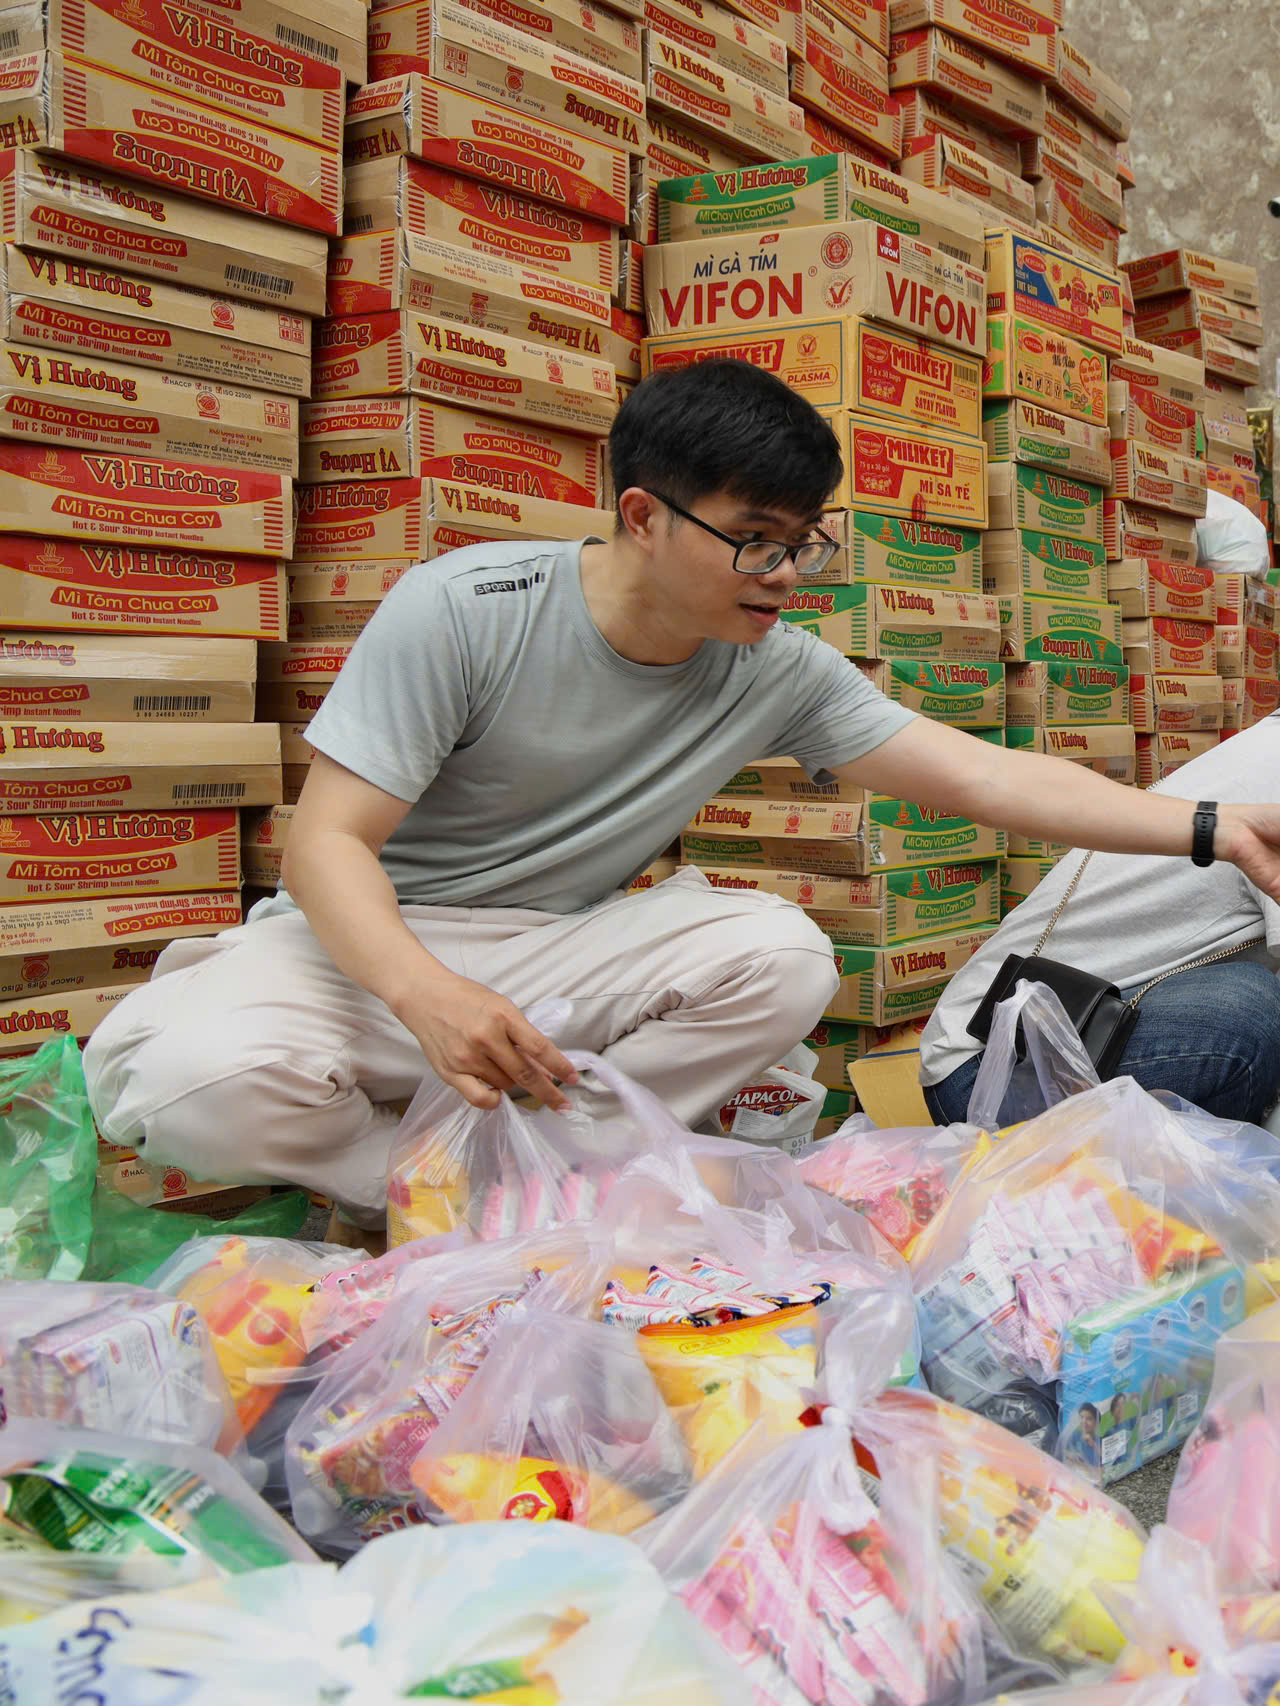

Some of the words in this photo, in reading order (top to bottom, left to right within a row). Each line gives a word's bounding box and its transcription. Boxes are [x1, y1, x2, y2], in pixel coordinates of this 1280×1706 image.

[162, 6, 201, 48] Vị
[207, 20, 303, 86] Hương
[138, 42, 161, 65] Mì
[163, 49, 199, 78] Tôm
[202, 69, 245, 96] Chua
[248, 82, 280, 106] Cay
[659, 42, 677, 68] Vị
[680, 54, 725, 93] Hương
[150, 68, 164, 81] Hot
[165, 72, 172, 82] &
[175, 77, 193, 90] Sour
[194, 82, 223, 101] Shrimp
[224, 94, 246, 108] Instant
[247, 101, 269, 117] Noodles
[113, 133, 217, 193] Hương
[458, 141, 535, 185] Hương
[38, 164, 72, 199] Vị
[77, 174, 166, 222] Hương
[223, 172, 258, 215] Vị
[537, 171, 564, 202] Vị
[715, 174, 736, 195] Vị
[741, 165, 807, 191] Hương
[479, 187, 507, 218] Vị
[512, 199, 583, 242] Hương
[36, 209, 60, 230] Mì
[62, 213, 100, 238] Tôm
[103, 227, 147, 250] Chua
[151, 237, 182, 255] Cay
[463, 221, 480, 238] Mì
[482, 228, 508, 247] Tôm
[510, 238, 542, 256] Chua
[544, 245, 567, 261] Cay
[694, 254, 714, 278] MÌ
[719, 252, 741, 274] GÀ
[749, 248, 777, 272] TÍM
[880, 245, 898, 259] VIFON
[23, 253, 58, 286] Vị
[65, 262, 152, 307] Hương
[1102, 290, 1113, 299] 10%
[659, 273, 802, 328] VIFON
[885, 271, 977, 346] VIFON
[418, 322, 441, 351] Vị
[447, 328, 507, 367] Hương
[8, 351, 42, 385] Vị
[48, 359, 138, 400] Hương
[787, 371, 831, 384] PLASMA
[891, 345, 947, 382] MILIKET
[886, 438, 947, 468] MILIKET
[81, 454, 125, 489] Vị
[133, 463, 239, 502] Hương
[920, 477, 933, 494] MÌ
[938, 483, 952, 497] SA
[955, 483, 969, 500] TẾ
[1047, 477, 1059, 498] Vị
[1060, 480, 1090, 506] Hương
[59, 498, 83, 515] Mì
[87, 502, 125, 521] Tôm
[130, 509, 178, 526] Chua
[181, 512, 216, 528] Cay
[899, 521, 916, 545] Vị
[918, 524, 962, 552] Hương
[81, 544, 124, 577] Vị
[129, 550, 234, 586] Hương
[476, 582, 514, 595] SPORT
[1042, 638, 1078, 654] Hương
[1079, 644, 1093, 660] Vị
[932, 664, 949, 686] Vị
[950, 664, 989, 687] Hương
[12, 727, 105, 752] Hương
[38, 816, 78, 846] Vị
[87, 814, 194, 841] Hương
[15, 864, 38, 877] Mì
[43, 864, 80, 877] Tôm
[86, 862, 133, 876] Chua
[137, 855, 170, 871] Cay
[27, 884, 43, 893] Hot
[45, 883, 52, 891] &
[54, 882, 76, 891] Sour
[78, 880, 108, 889] Shrimp
[135, 878, 159, 886] Noodles
[891, 956, 906, 977] Vị
[908, 950, 946, 972] Hương
[727, 1090, 798, 1106] HAPACOL
